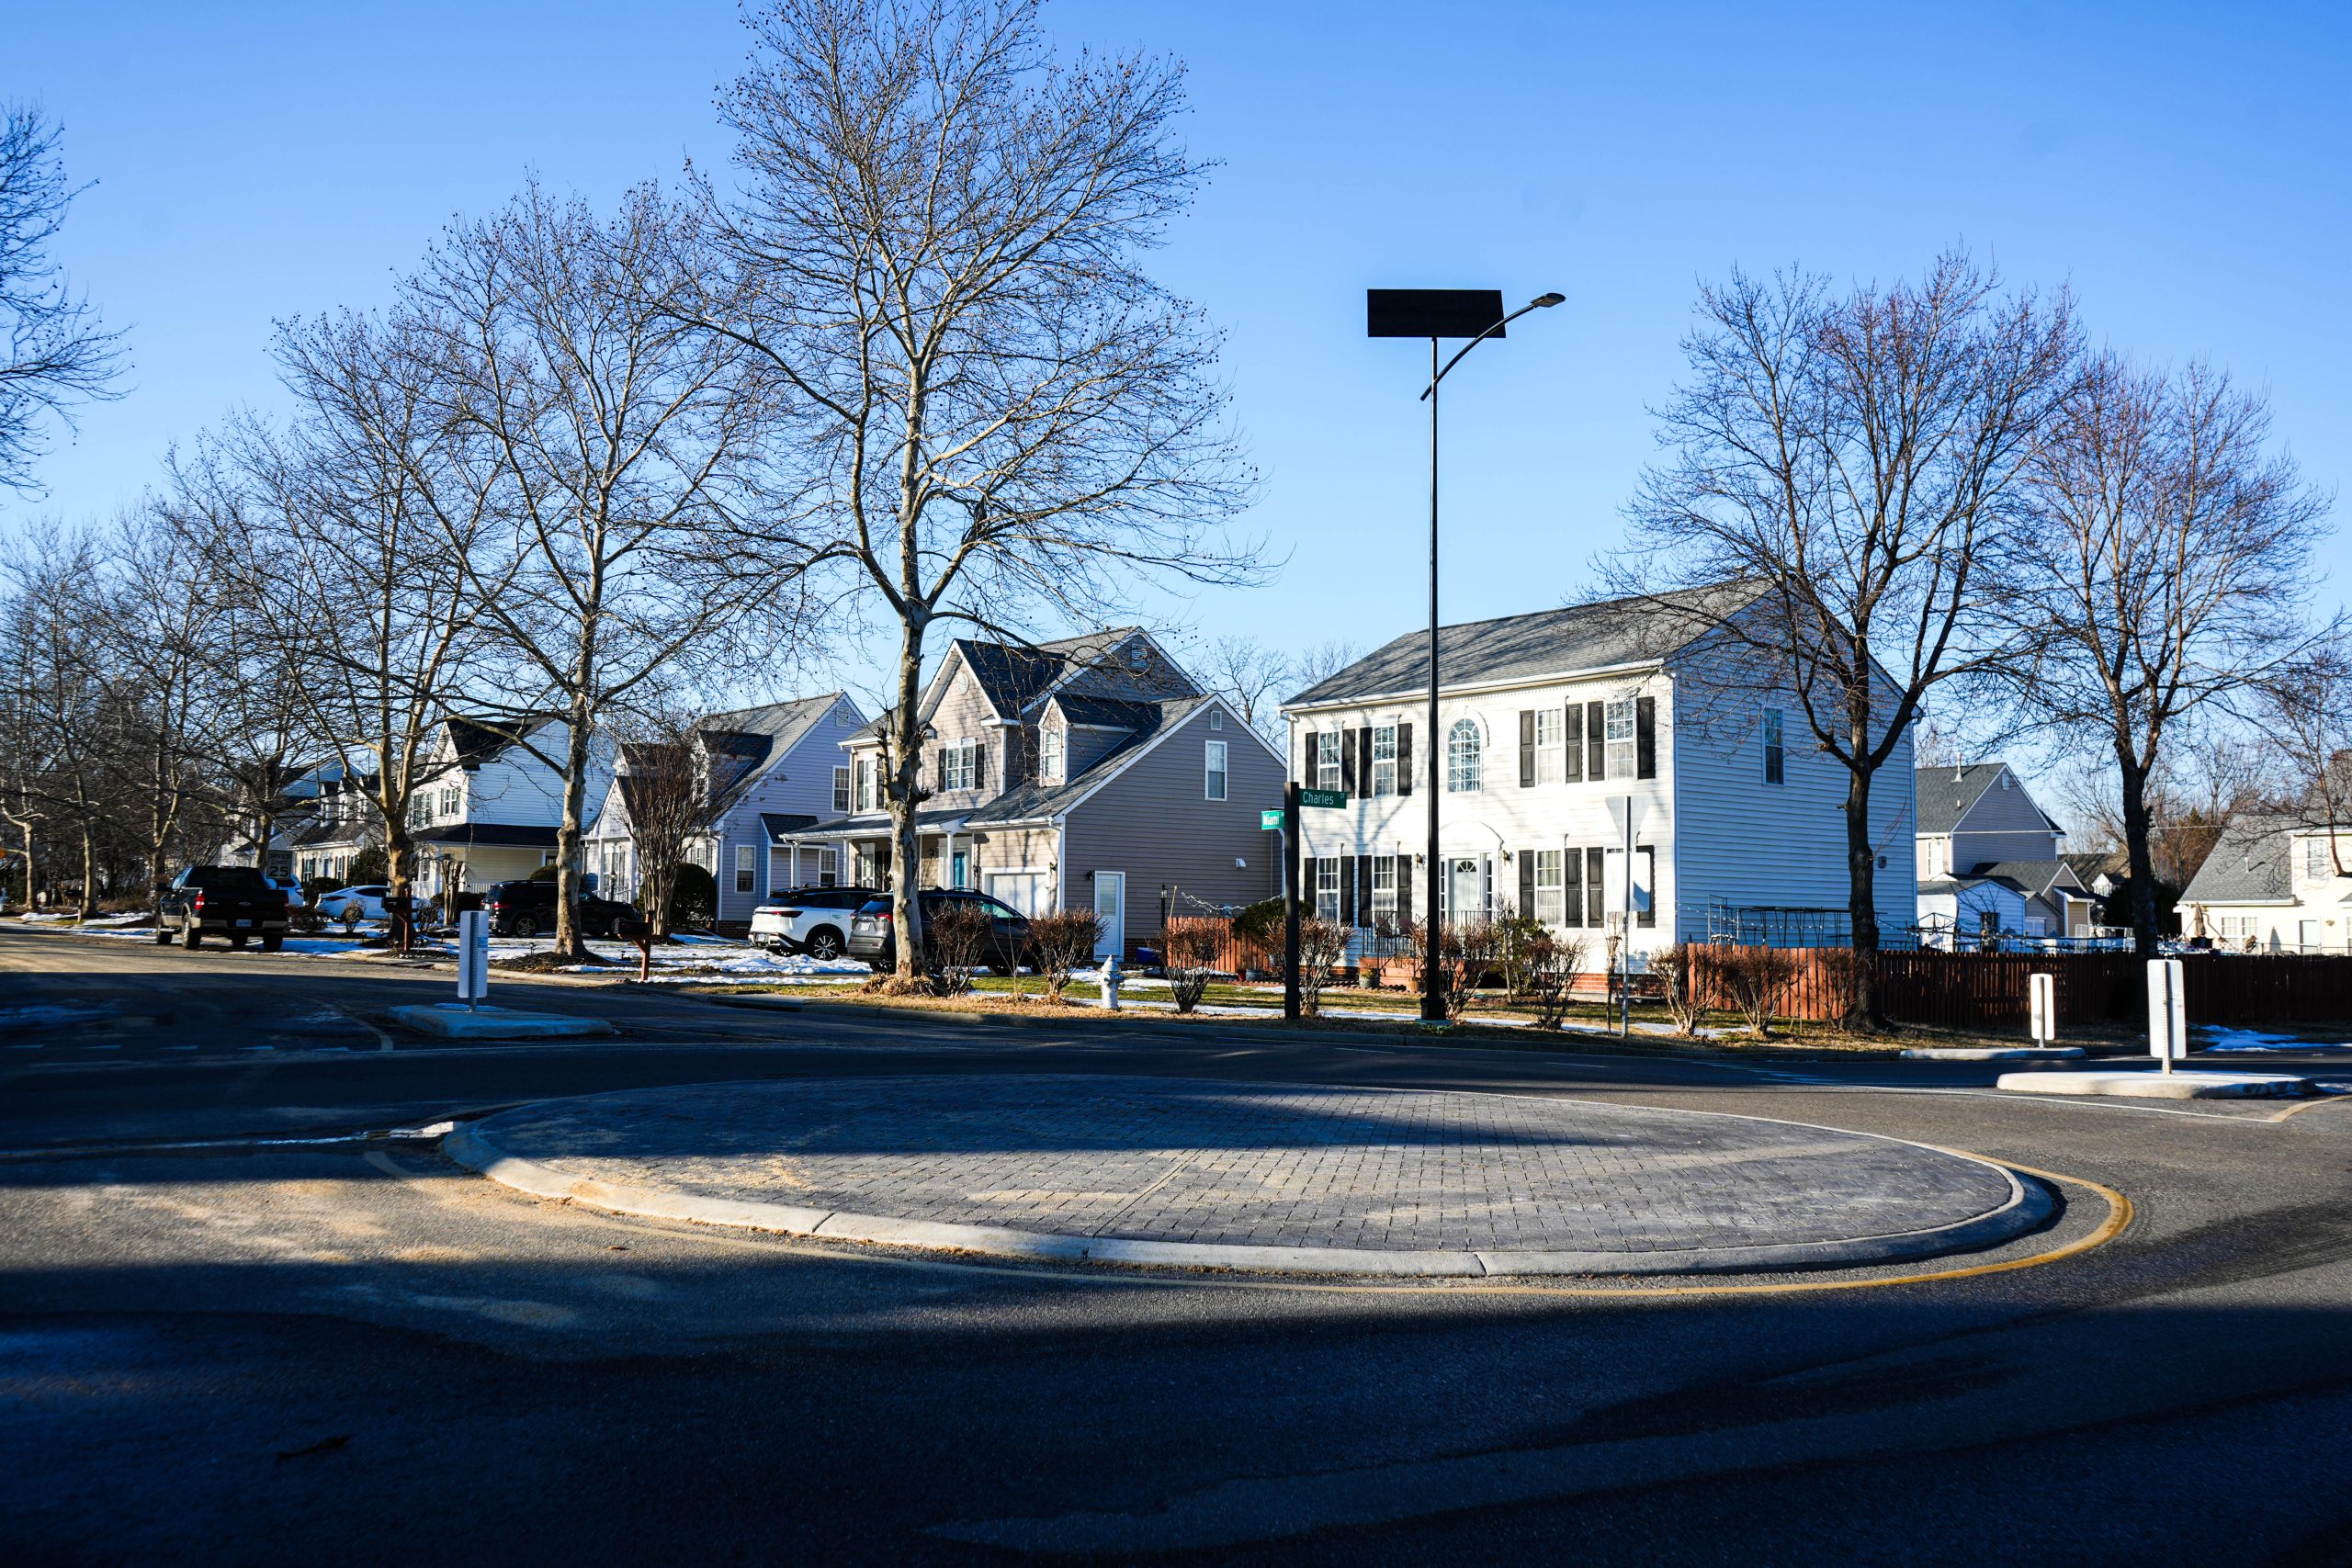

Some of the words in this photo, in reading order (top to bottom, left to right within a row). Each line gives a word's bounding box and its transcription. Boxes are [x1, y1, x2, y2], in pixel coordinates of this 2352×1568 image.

[1302, 791, 1334, 805] Charles
[1262, 814, 1280, 826] Miami
[269, 866, 288, 876] 25
